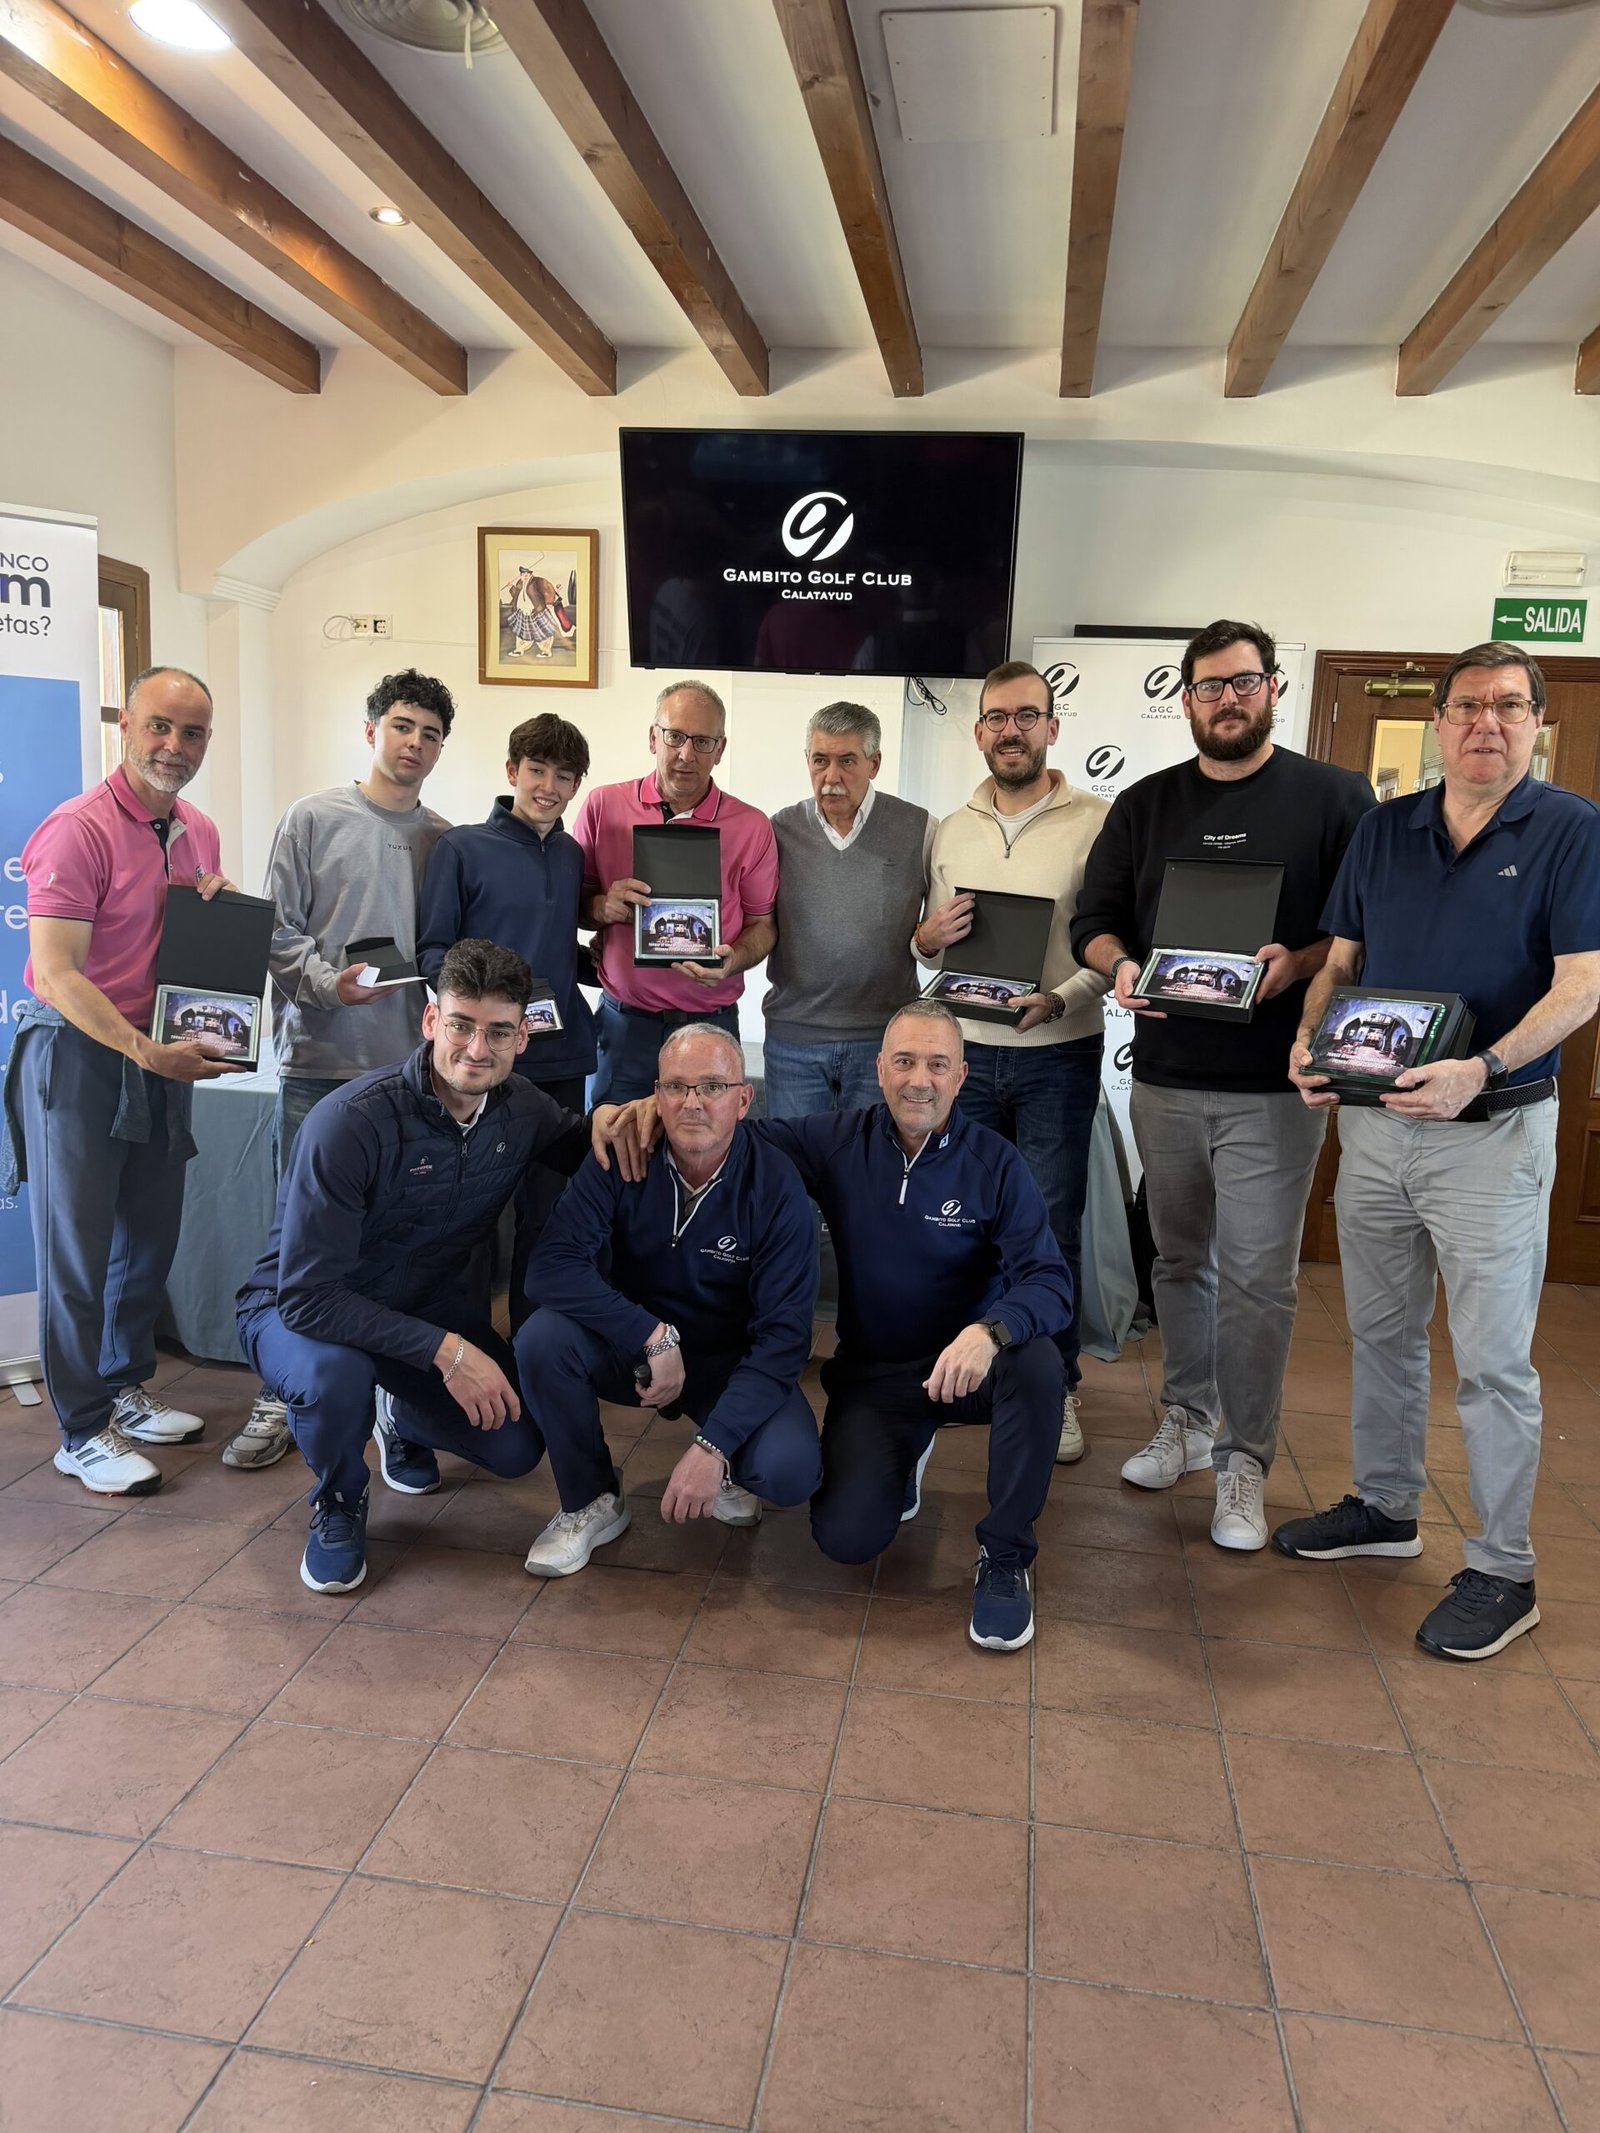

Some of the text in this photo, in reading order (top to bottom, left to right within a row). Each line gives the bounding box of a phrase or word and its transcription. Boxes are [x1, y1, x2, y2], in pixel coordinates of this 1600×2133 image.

[723, 568, 912, 586] GAMBITO GOLF CLUB
[781, 589, 853, 600] CALATAYUD
[1523, 606, 1582, 633] SALIDA
[1054, 703, 1070, 711] GC
[1149, 705, 1174, 713] GGC
[1091, 784, 1115, 793] GGC
